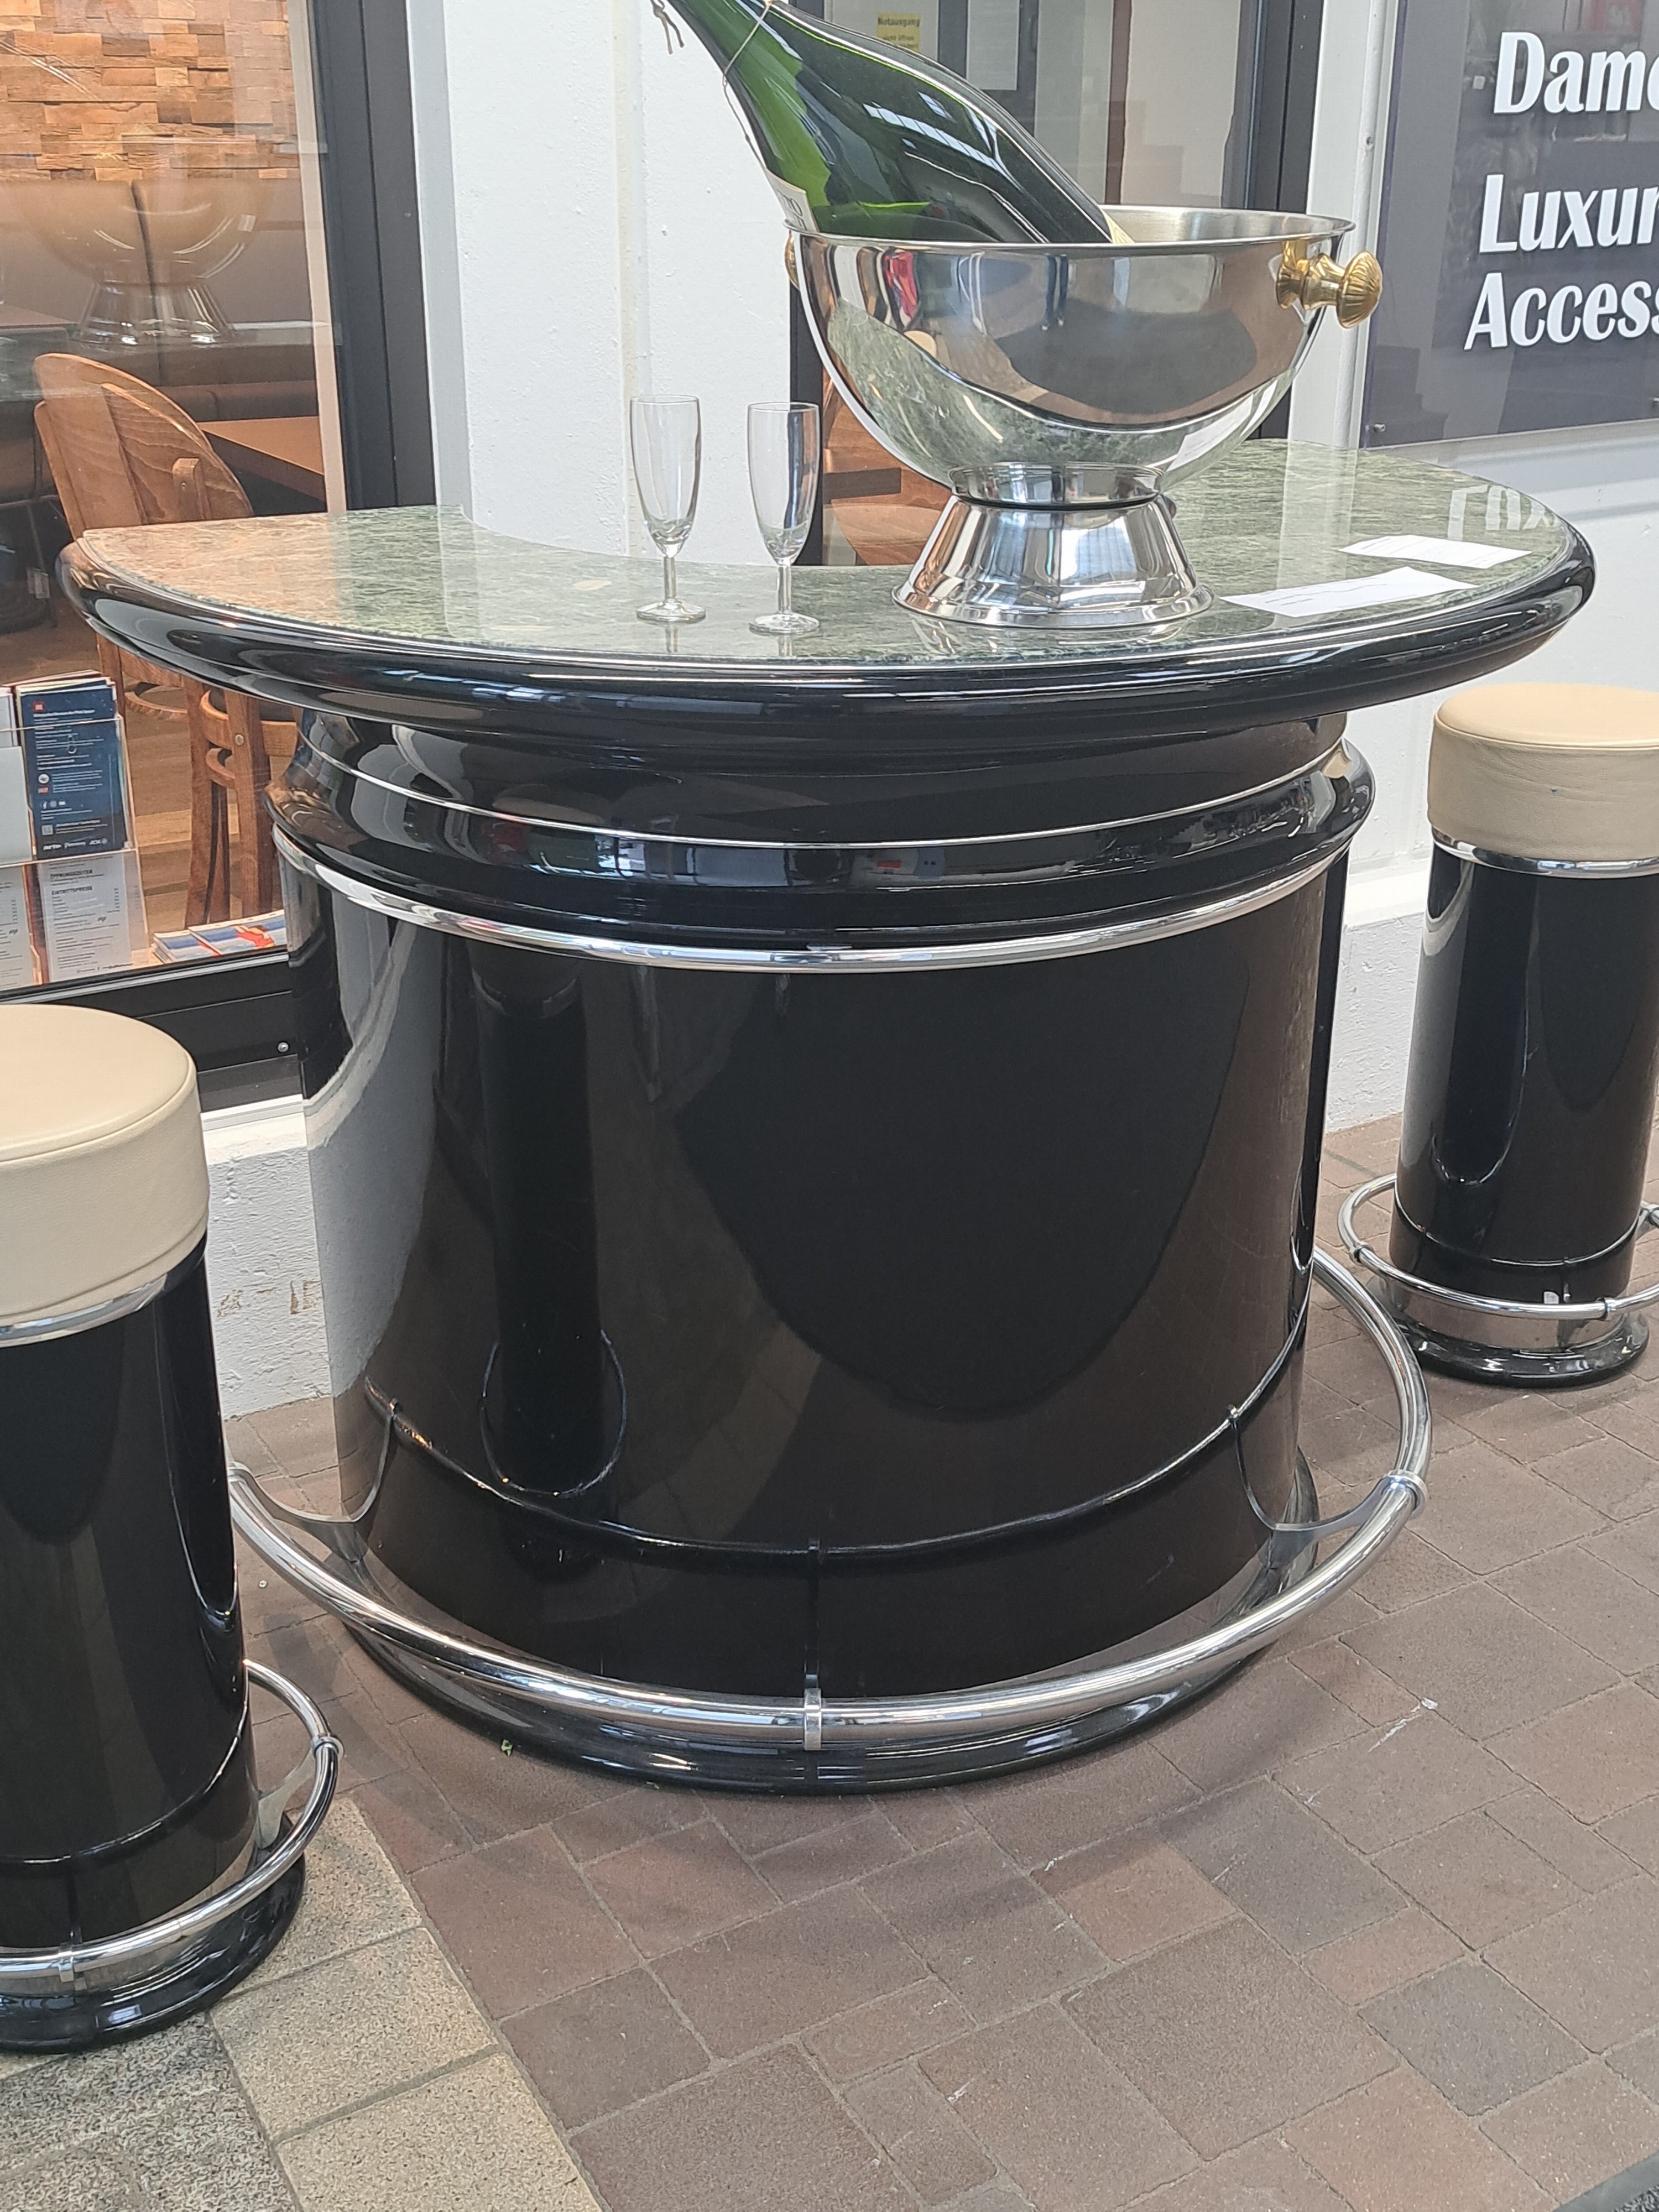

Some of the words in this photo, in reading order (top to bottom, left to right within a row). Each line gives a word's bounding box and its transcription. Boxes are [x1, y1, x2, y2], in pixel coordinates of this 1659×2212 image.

[878, 17, 920, 27] Notausgang
[1479, 174, 1659, 253] Luxur
[1464, 272, 1659, 351] Acces
